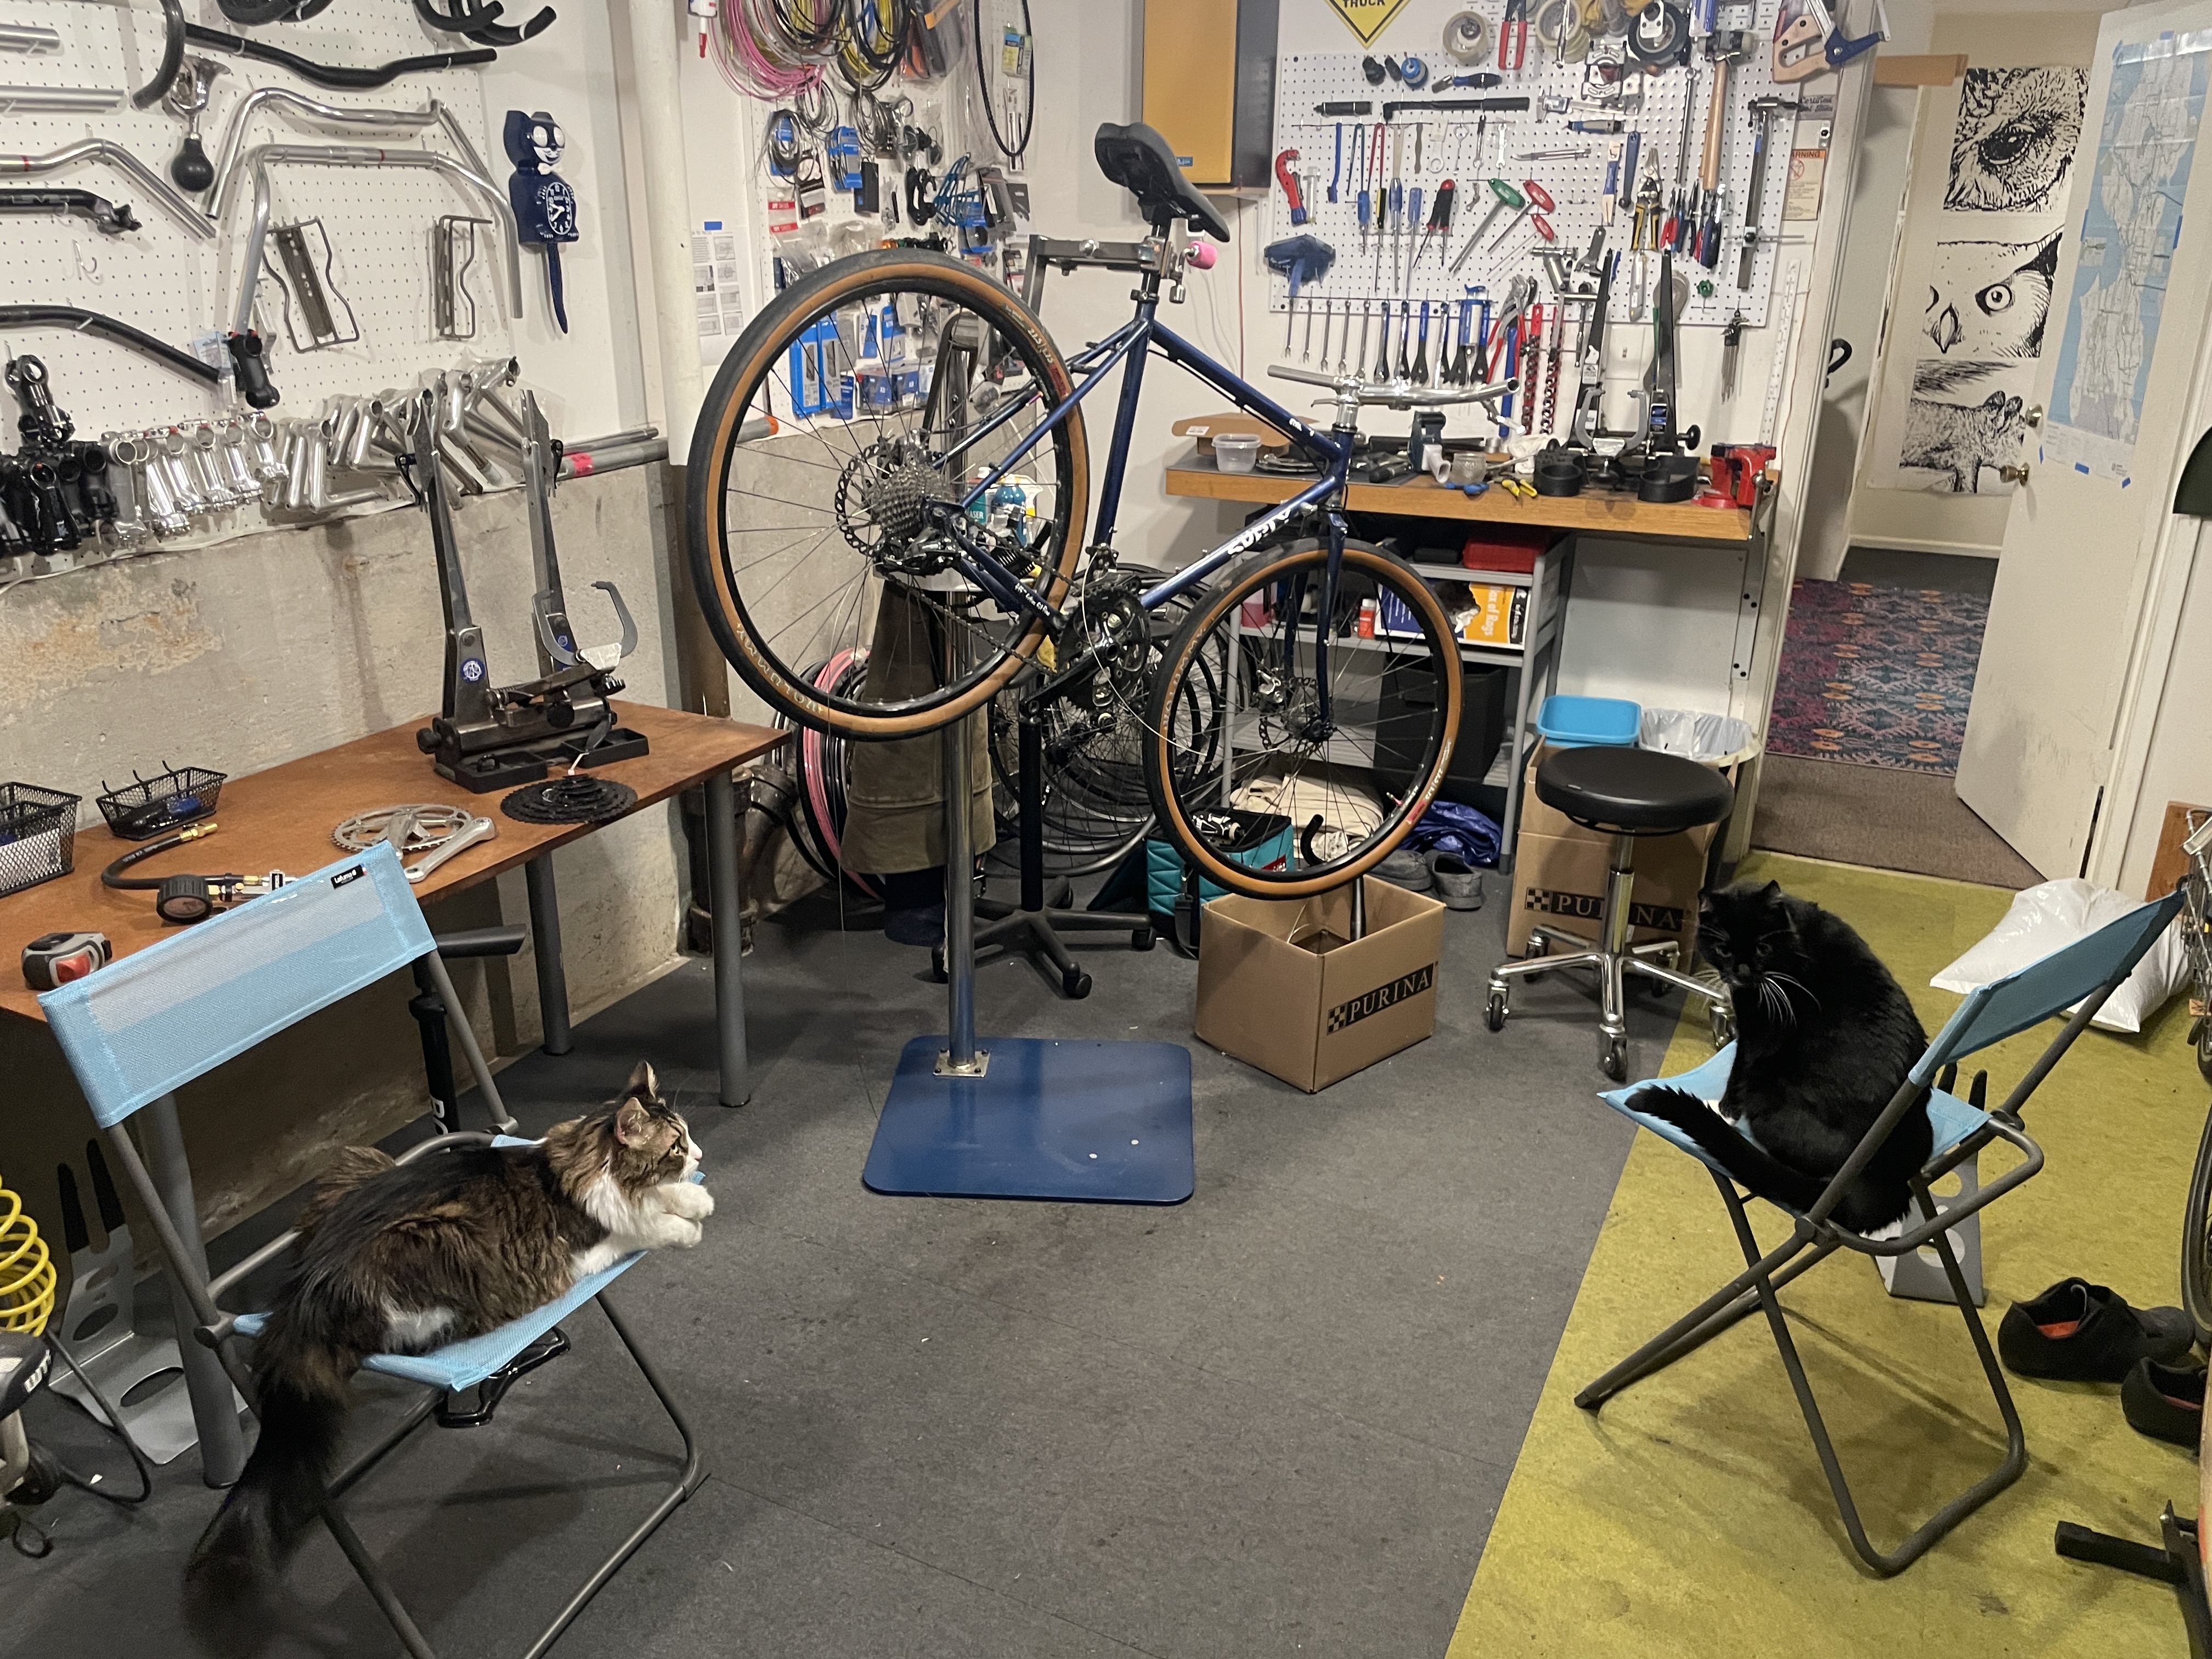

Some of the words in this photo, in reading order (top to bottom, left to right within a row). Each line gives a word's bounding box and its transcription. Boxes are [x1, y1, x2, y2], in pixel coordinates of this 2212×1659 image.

[969, 511, 984, 520] ASER
[1556, 894, 1677, 929] PUNA
[1348, 969, 1430, 1023] PURINA
